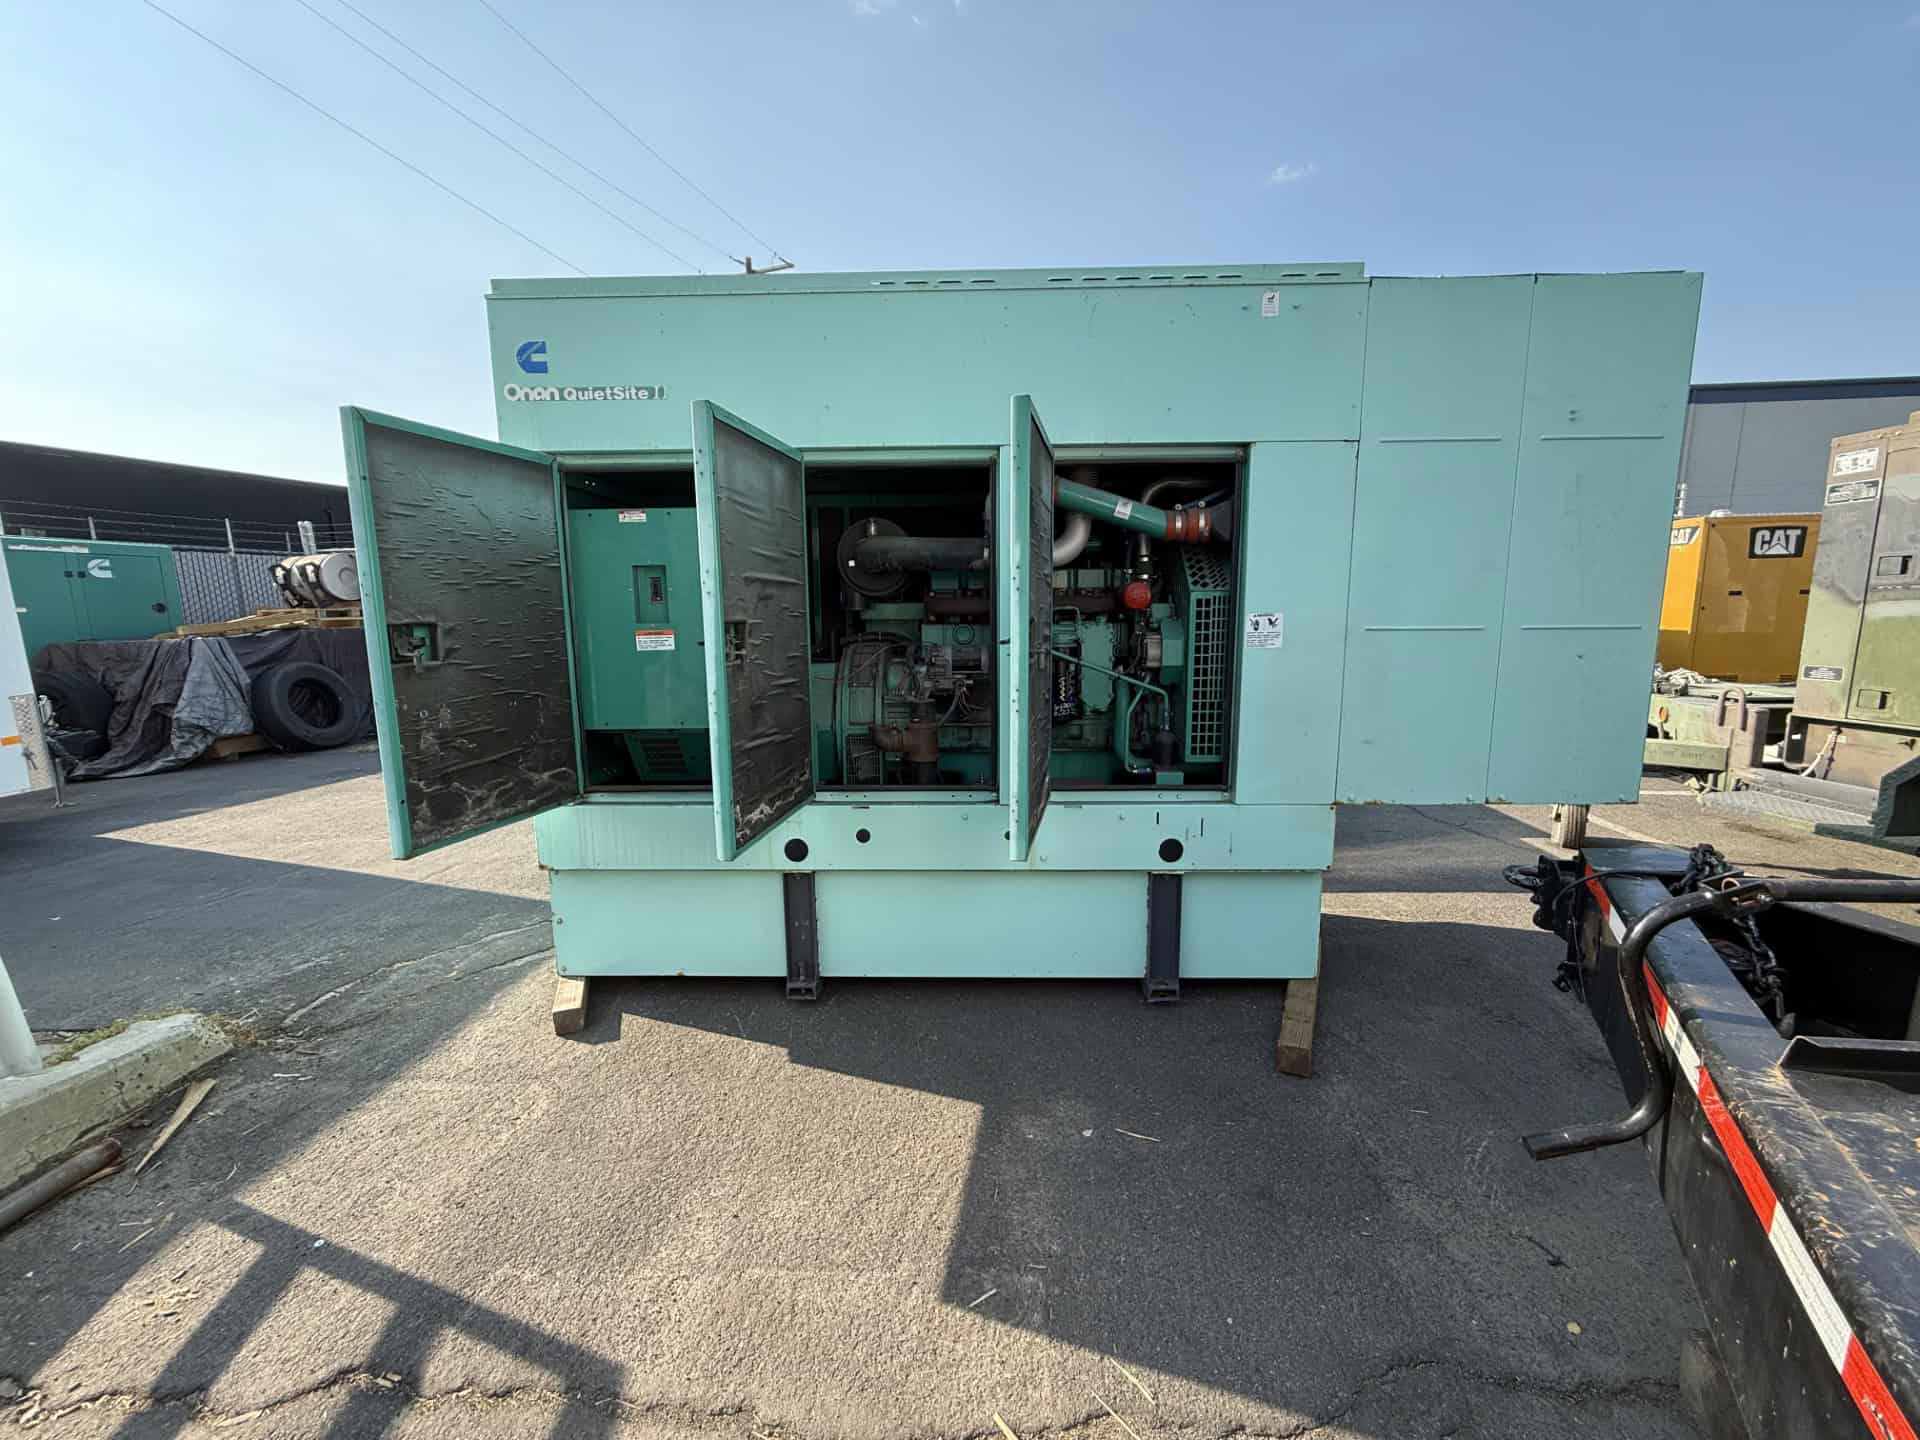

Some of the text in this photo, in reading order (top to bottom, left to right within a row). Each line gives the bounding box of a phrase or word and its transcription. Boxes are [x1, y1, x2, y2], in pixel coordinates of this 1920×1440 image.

[504, 384, 560, 401] Onan
[563, 385, 649, 401] QuietSite
[1671, 528, 1692, 544] CAT
[1754, 529, 1802, 555] CAT
